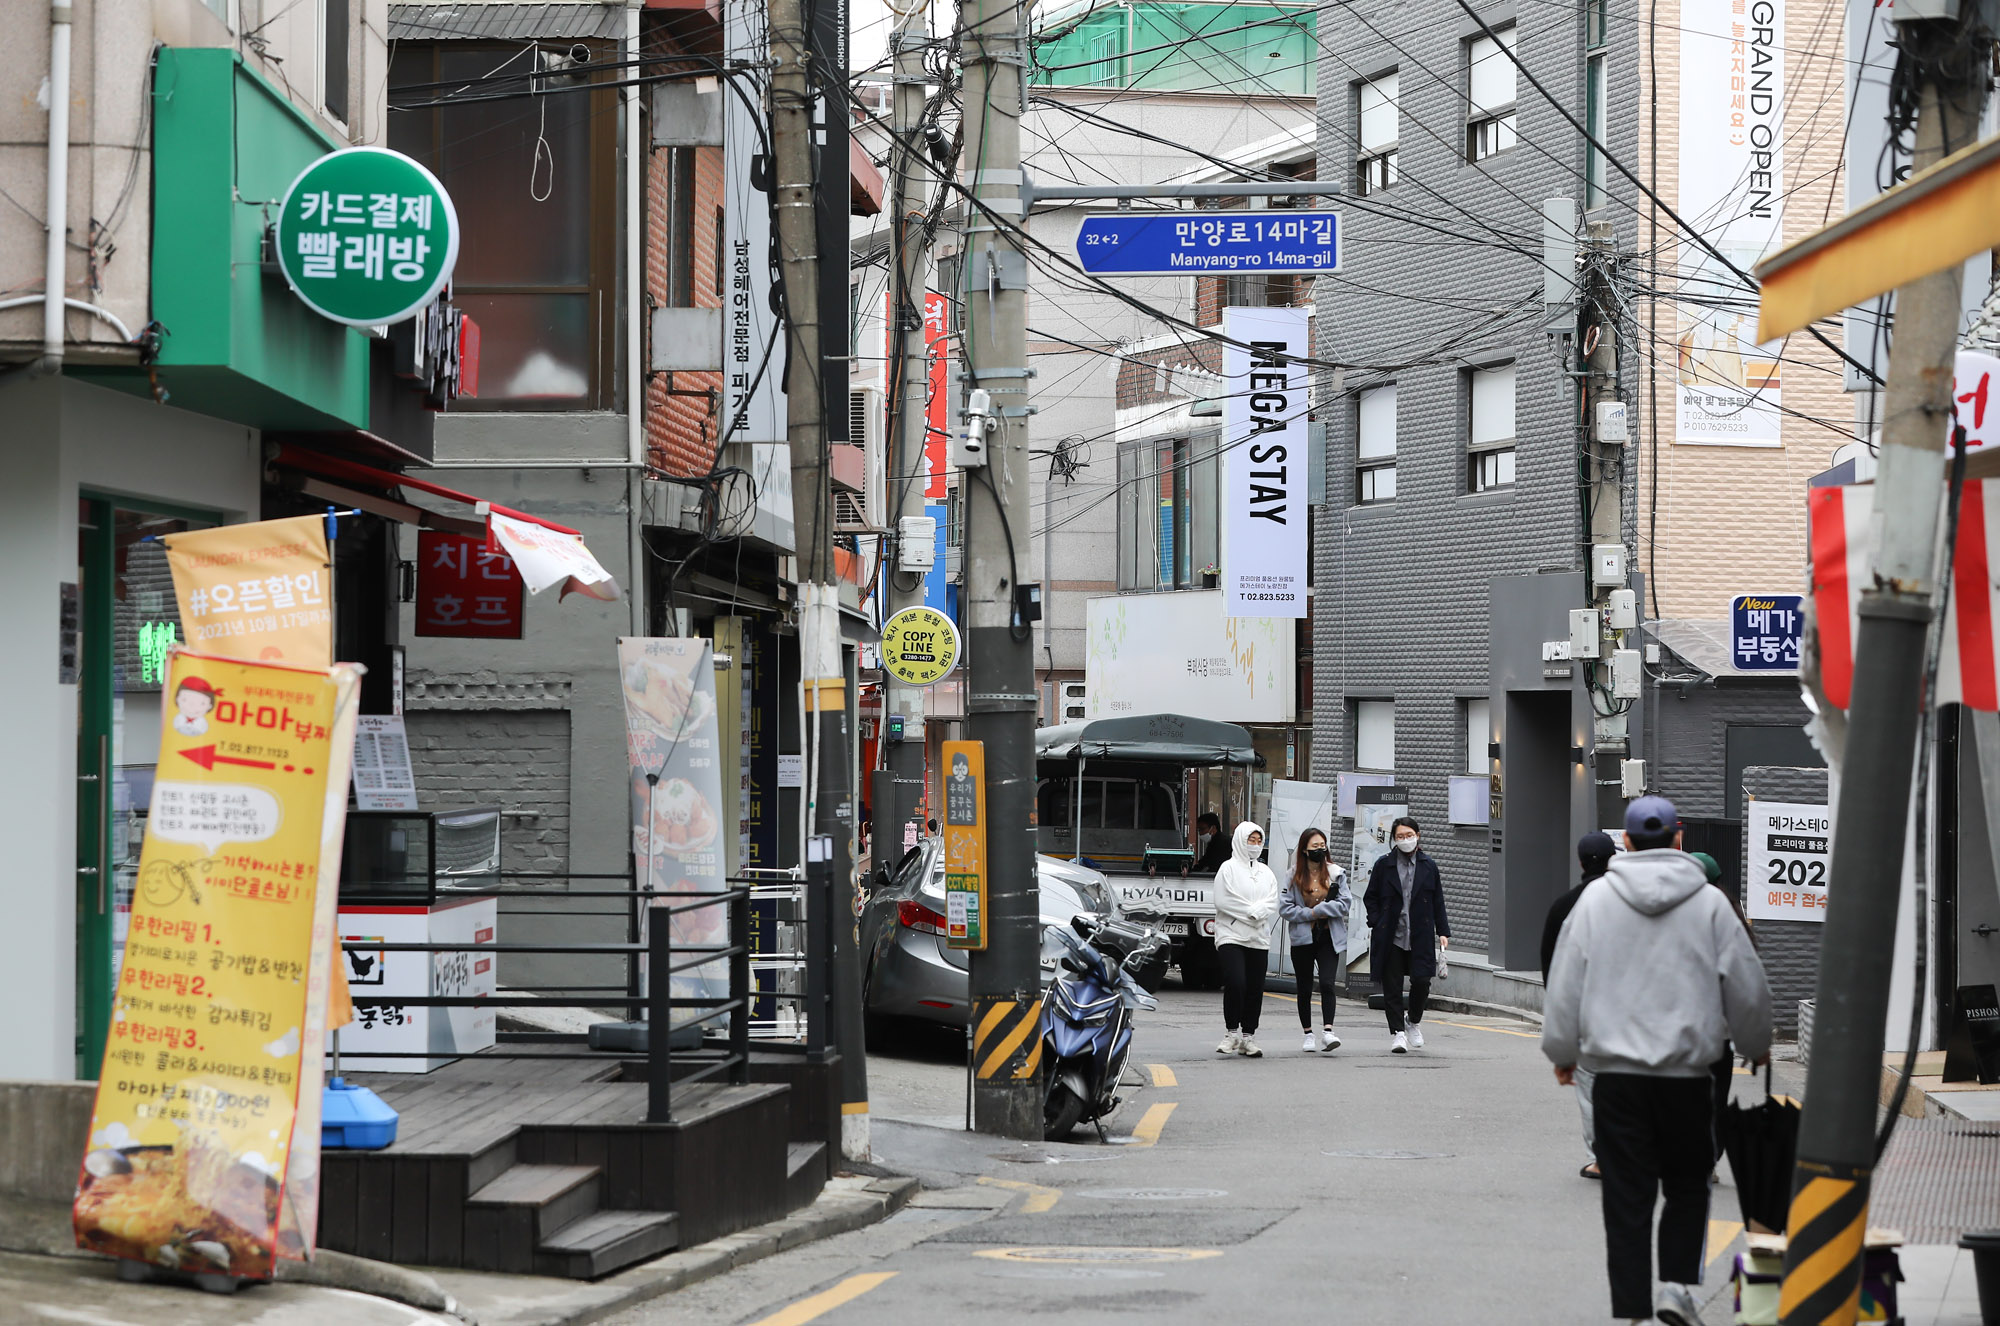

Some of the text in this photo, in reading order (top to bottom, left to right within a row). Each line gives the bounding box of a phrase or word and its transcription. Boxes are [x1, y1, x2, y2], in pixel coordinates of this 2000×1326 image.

[1749, 1, 1774, 219] GRAND OPEN!
[300, 191, 432, 230] 카드결제
[298, 232, 431, 282] 빨래방
[1170, 251, 1331, 268] Manyang-ro 14ma-gil
[733, 240, 750, 362] 남성헤어전문점
[1684, 396, 1702, 406] 예약
[1706, 396, 1714, 407] 및
[1684, 412, 1742, 421] T 02.823.5233
[1250, 342, 1288, 525] MEGA STAY
[1684, 422, 1749, 432] P 010.7629.5233
[187, 553, 245, 569] LAUNDRY
[432, 543, 512, 580] 치킨
[189, 570, 324, 617] #오픈할인
[1247, 593, 1295, 601] 02.823.5233
[427, 594, 512, 626] 호프
[1738, 597, 1775, 610] New
[1748, 610, 1796, 634] 메가
[903, 631, 935, 642] COPY
[903, 642, 933, 653] LINE
[1738, 636, 1801, 663] 부동산
[949, 783, 972, 794] 우리가
[1395, 793, 1406, 801] STAY
[950, 810, 972, 821] 고시촌
[1773, 838, 1806, 850] 프리미엄
[1768, 859, 1827, 887] 202
[1768, 891, 1798, 907] 예약
[1966, 1008, 1999, 1018] PISHON
